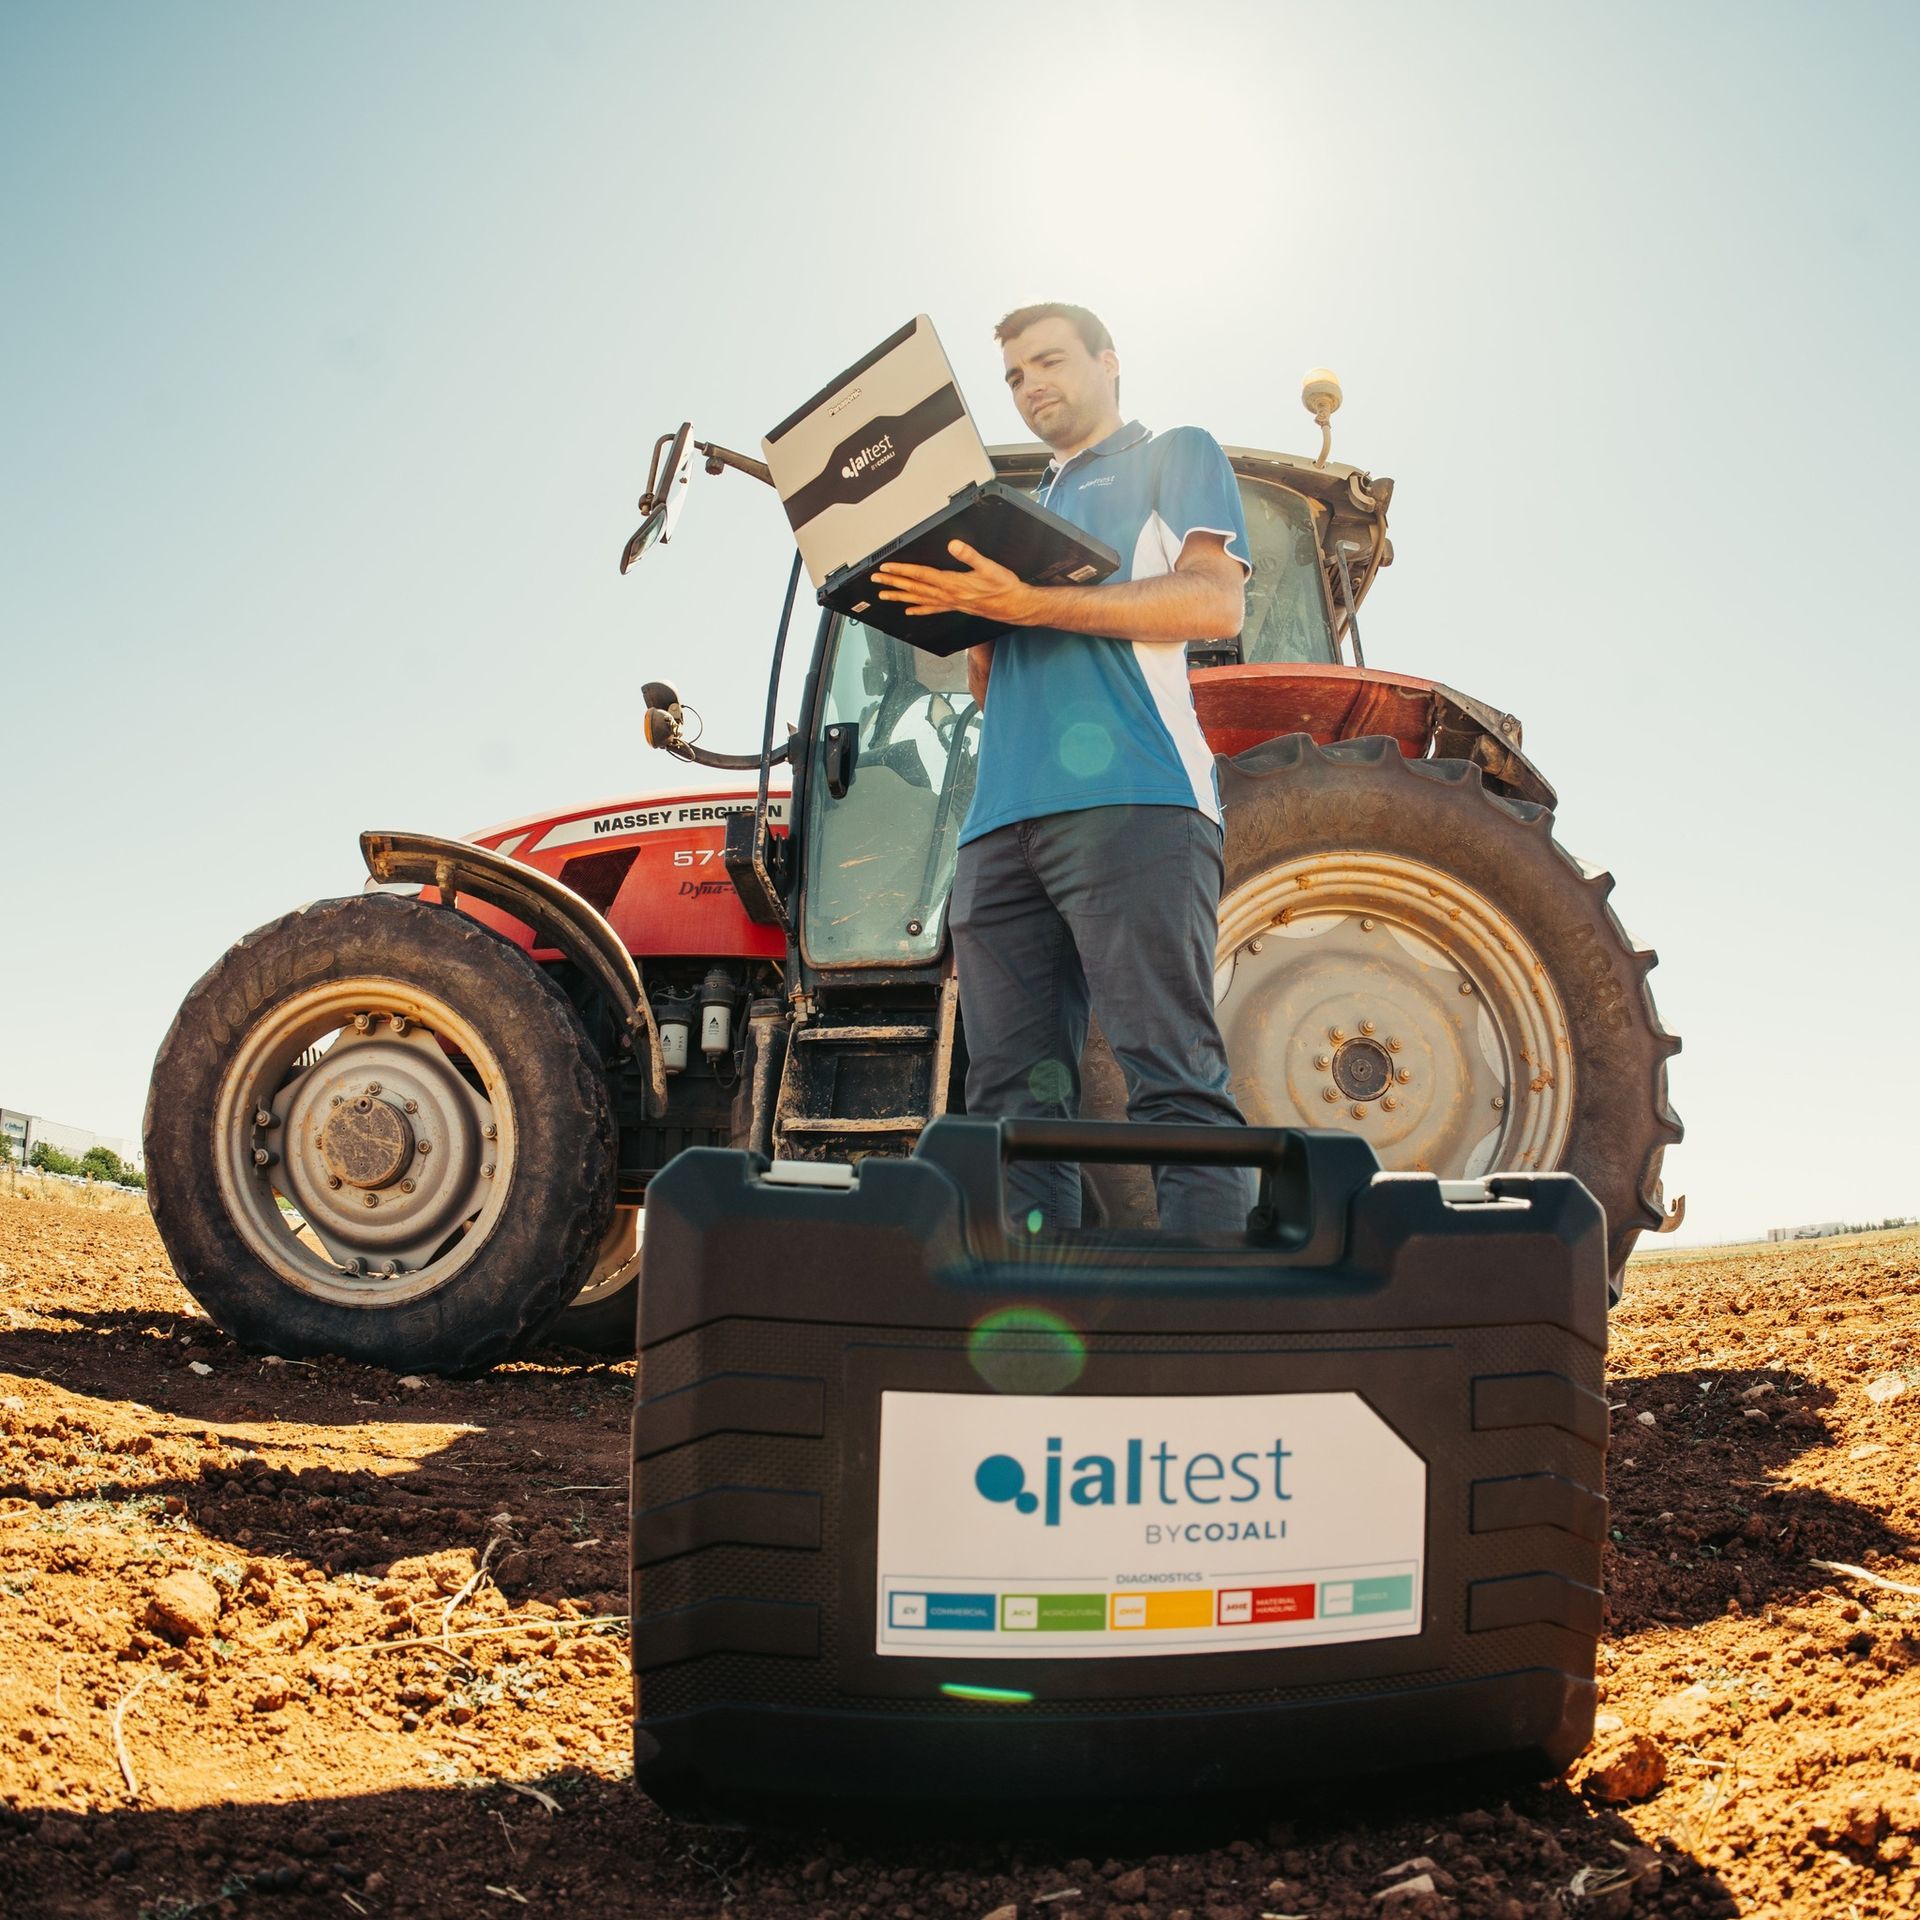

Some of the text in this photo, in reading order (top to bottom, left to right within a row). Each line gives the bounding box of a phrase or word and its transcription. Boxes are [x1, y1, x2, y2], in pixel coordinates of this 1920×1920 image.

[828, 388, 861, 417] Panasonic
[848, 434, 894, 478] jaltest
[593, 804, 782, 834] MASSEY FERGN
[1044, 1436, 1294, 1527] jaltest
[1115, 1572, 1203, 1585] DIAGNOSTICS
[1256, 1597, 1296, 1607] MATERIAL
[929, 1607, 989, 1617] COMMERCIAL
[1041, 1608, 1103, 1618] AGRICULTURAL
[1256, 1604, 1298, 1615] HANDLING
